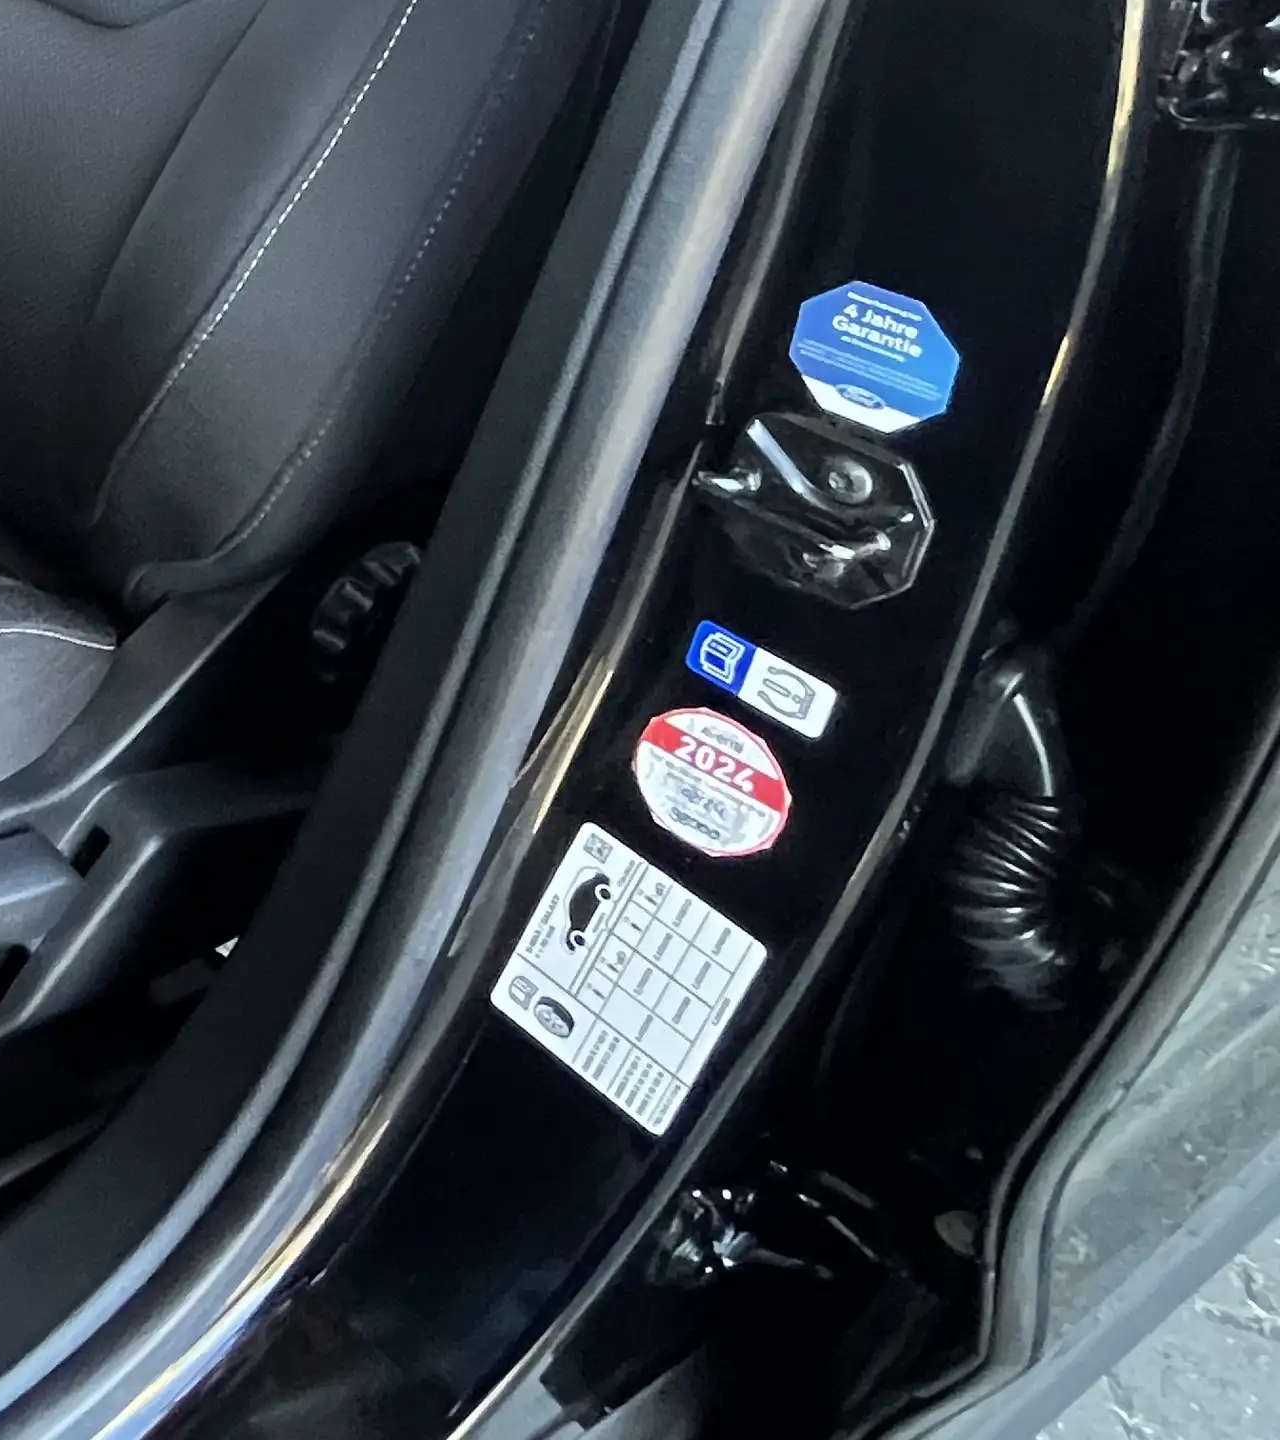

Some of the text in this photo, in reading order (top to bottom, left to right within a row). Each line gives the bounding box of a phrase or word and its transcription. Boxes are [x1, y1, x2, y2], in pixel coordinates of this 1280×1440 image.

[831, 314, 923, 358] Garantie
[843, 303, 858, 318] 4
[861, 308, 919, 340] Jahre
[673, 735, 755, 793] 2024
